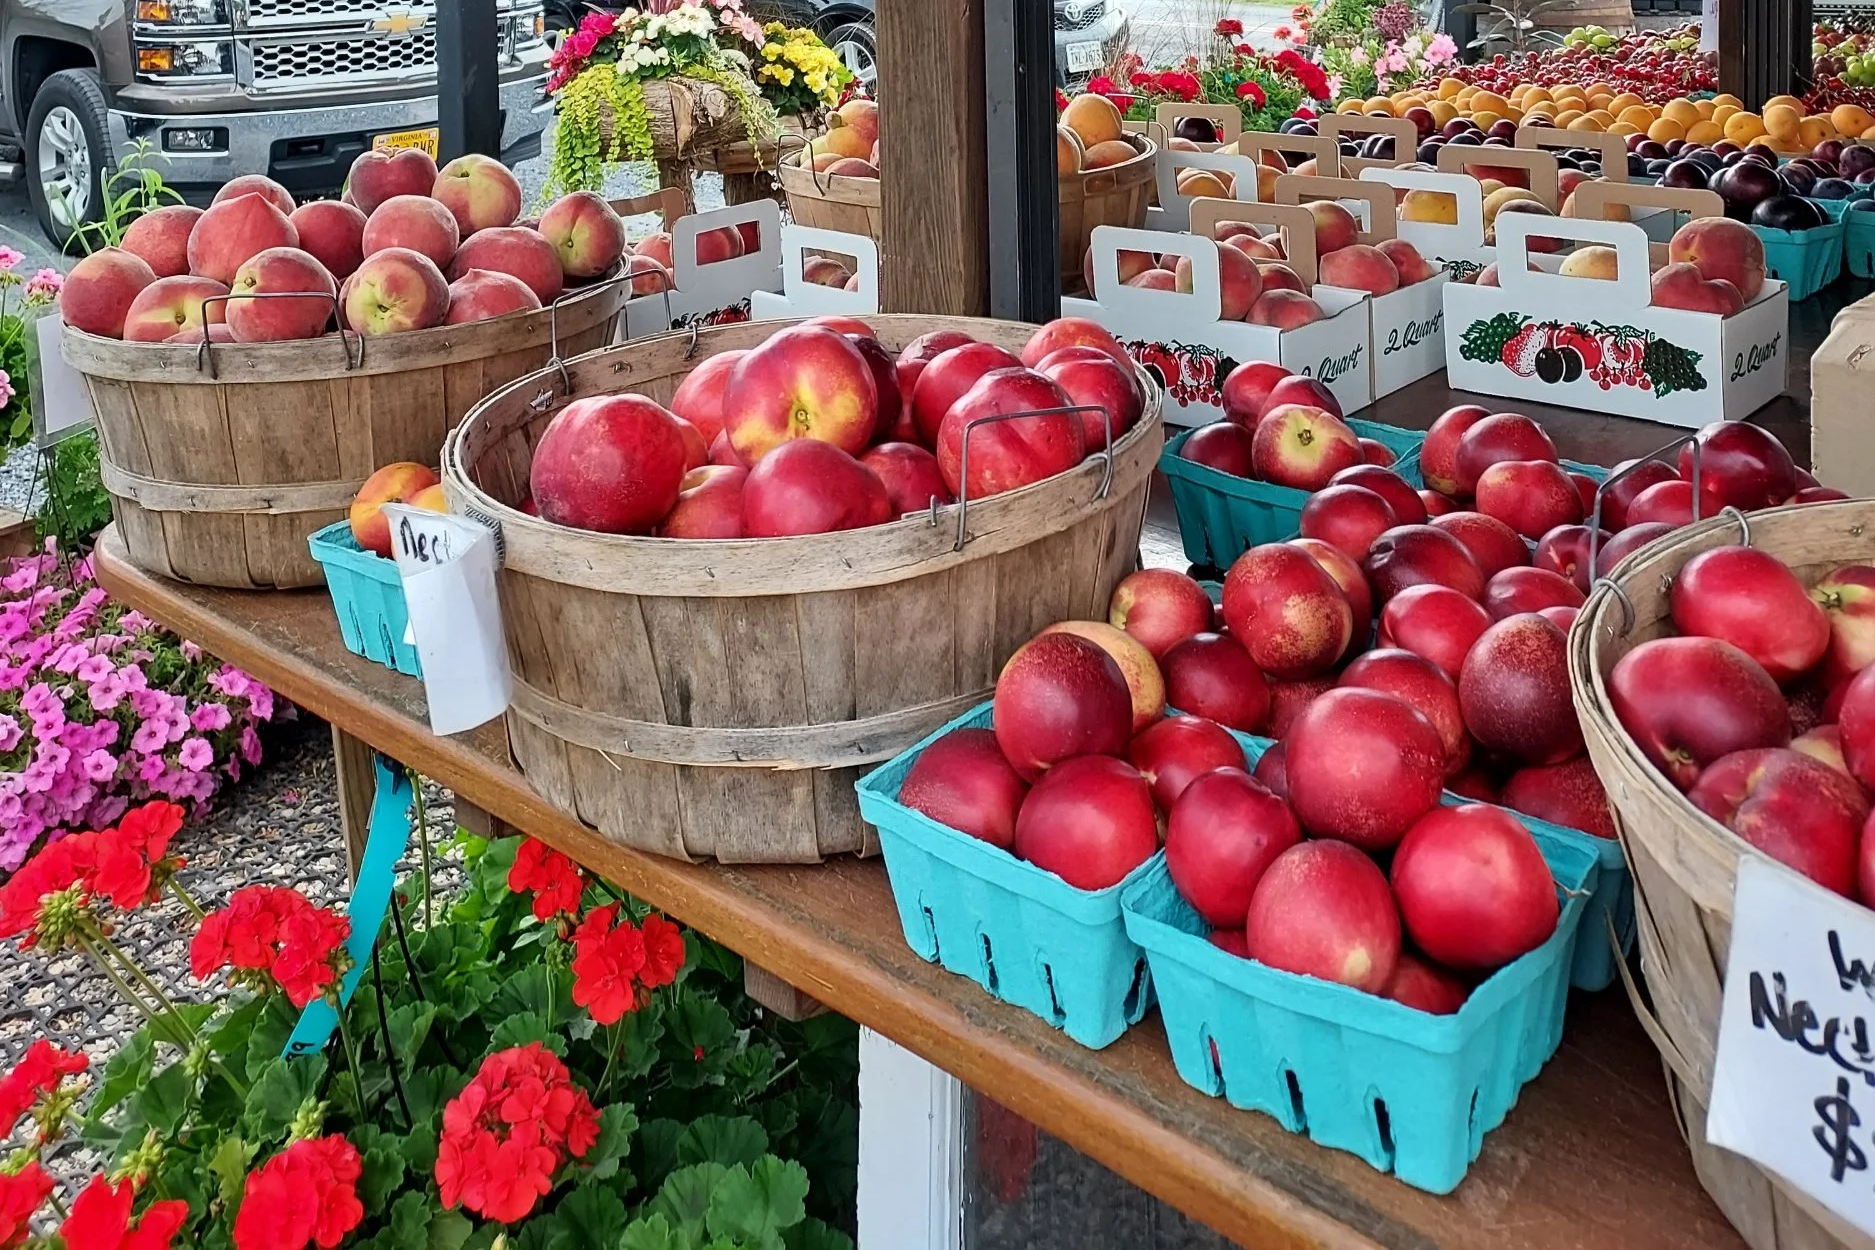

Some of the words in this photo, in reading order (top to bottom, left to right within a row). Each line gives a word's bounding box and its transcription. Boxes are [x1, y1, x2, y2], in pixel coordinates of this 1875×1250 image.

[391, 133, 422, 143] VIRGINIA
[1384, 328, 1402, 356] 2
[1402, 309, 1443, 349] Quart
[1317, 343, 1363, 384] Quart
[1730, 352, 1747, 382] 2
[1747, 331, 1782, 374] Quart
